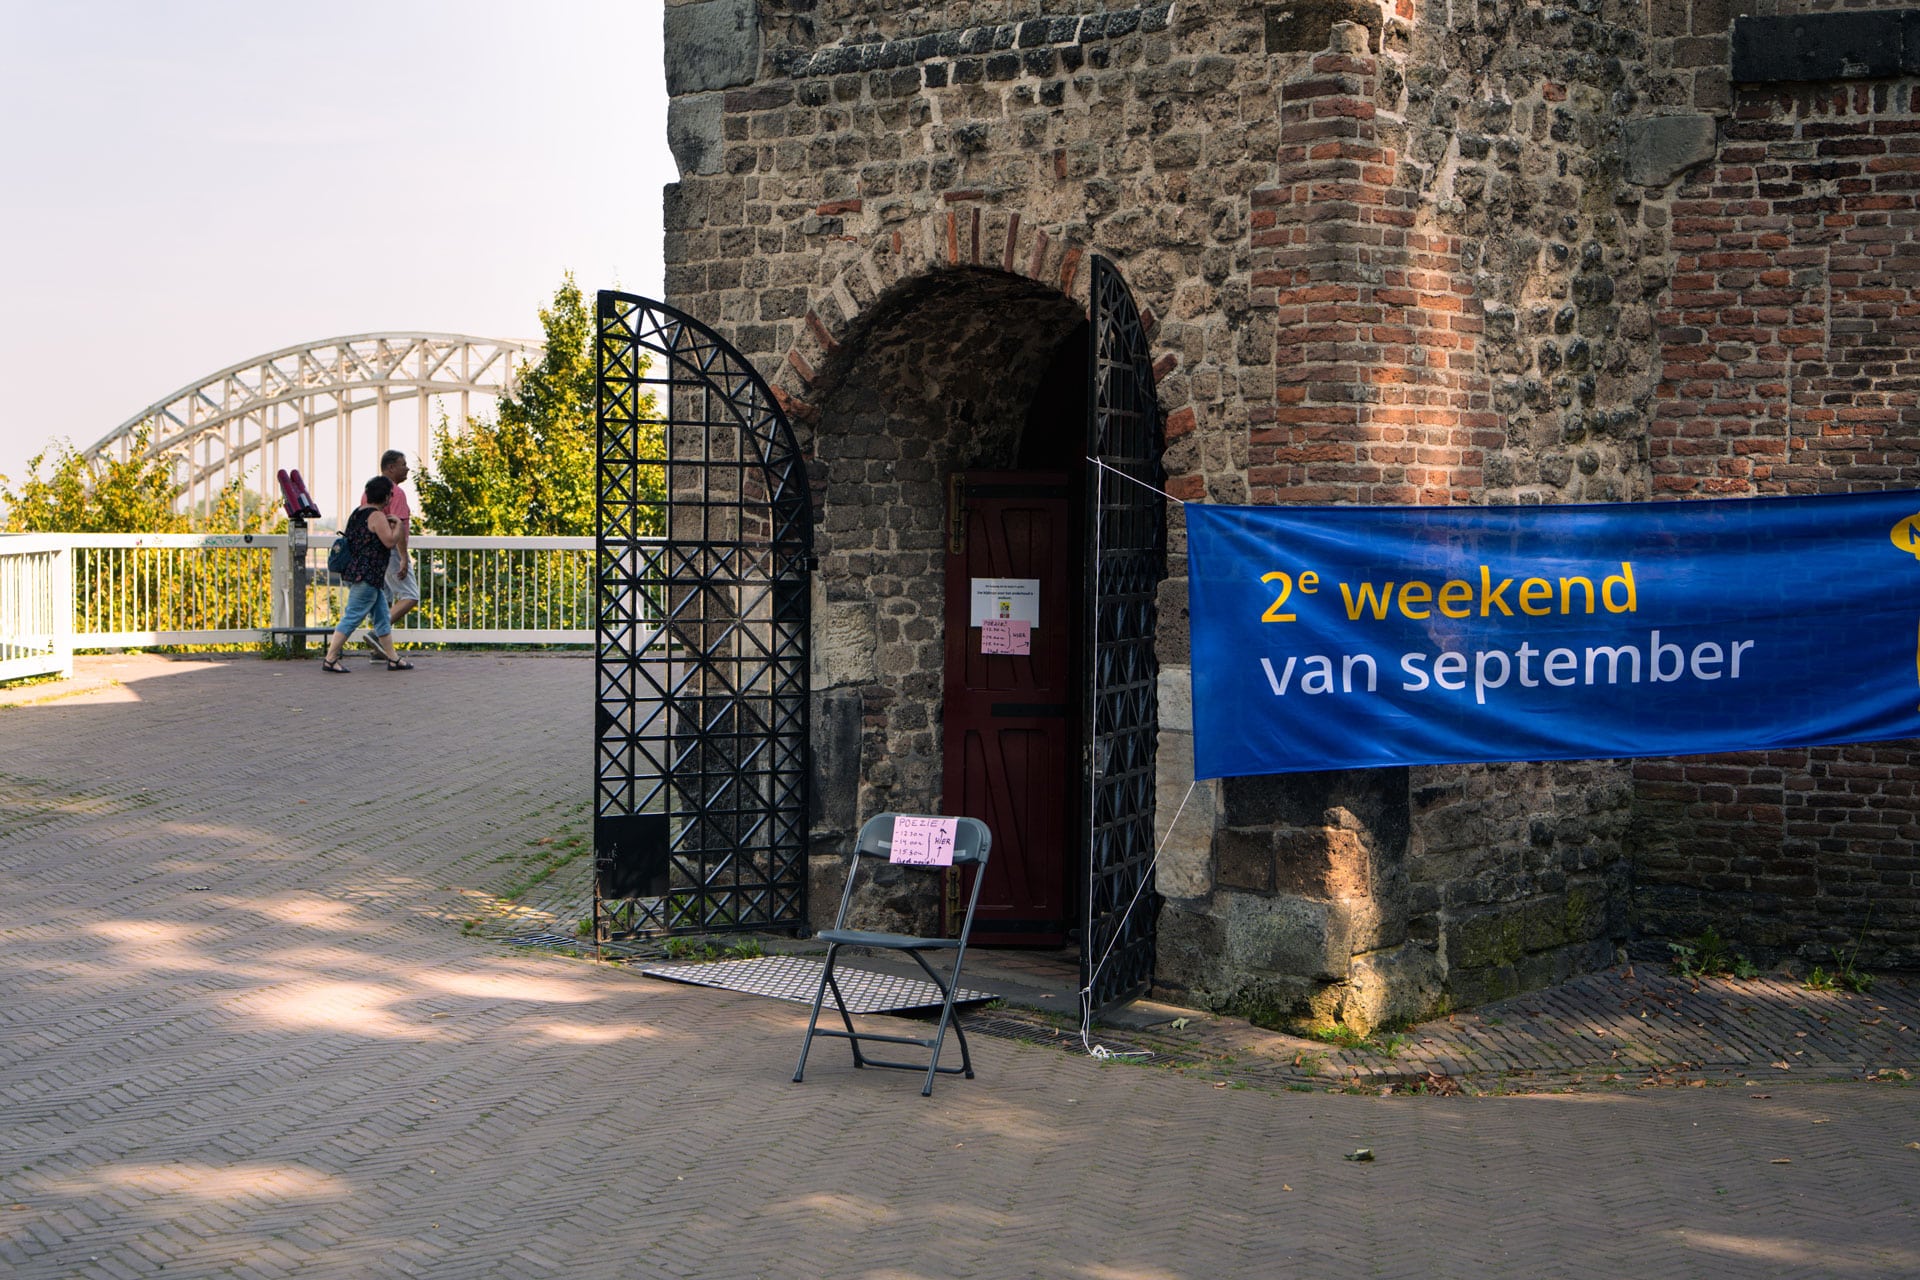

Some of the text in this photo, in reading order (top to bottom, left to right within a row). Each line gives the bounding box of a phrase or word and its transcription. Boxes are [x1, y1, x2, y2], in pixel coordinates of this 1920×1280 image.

[1260, 562, 1637, 623] 2e weekend
[1260, 630, 1755, 705] van september
